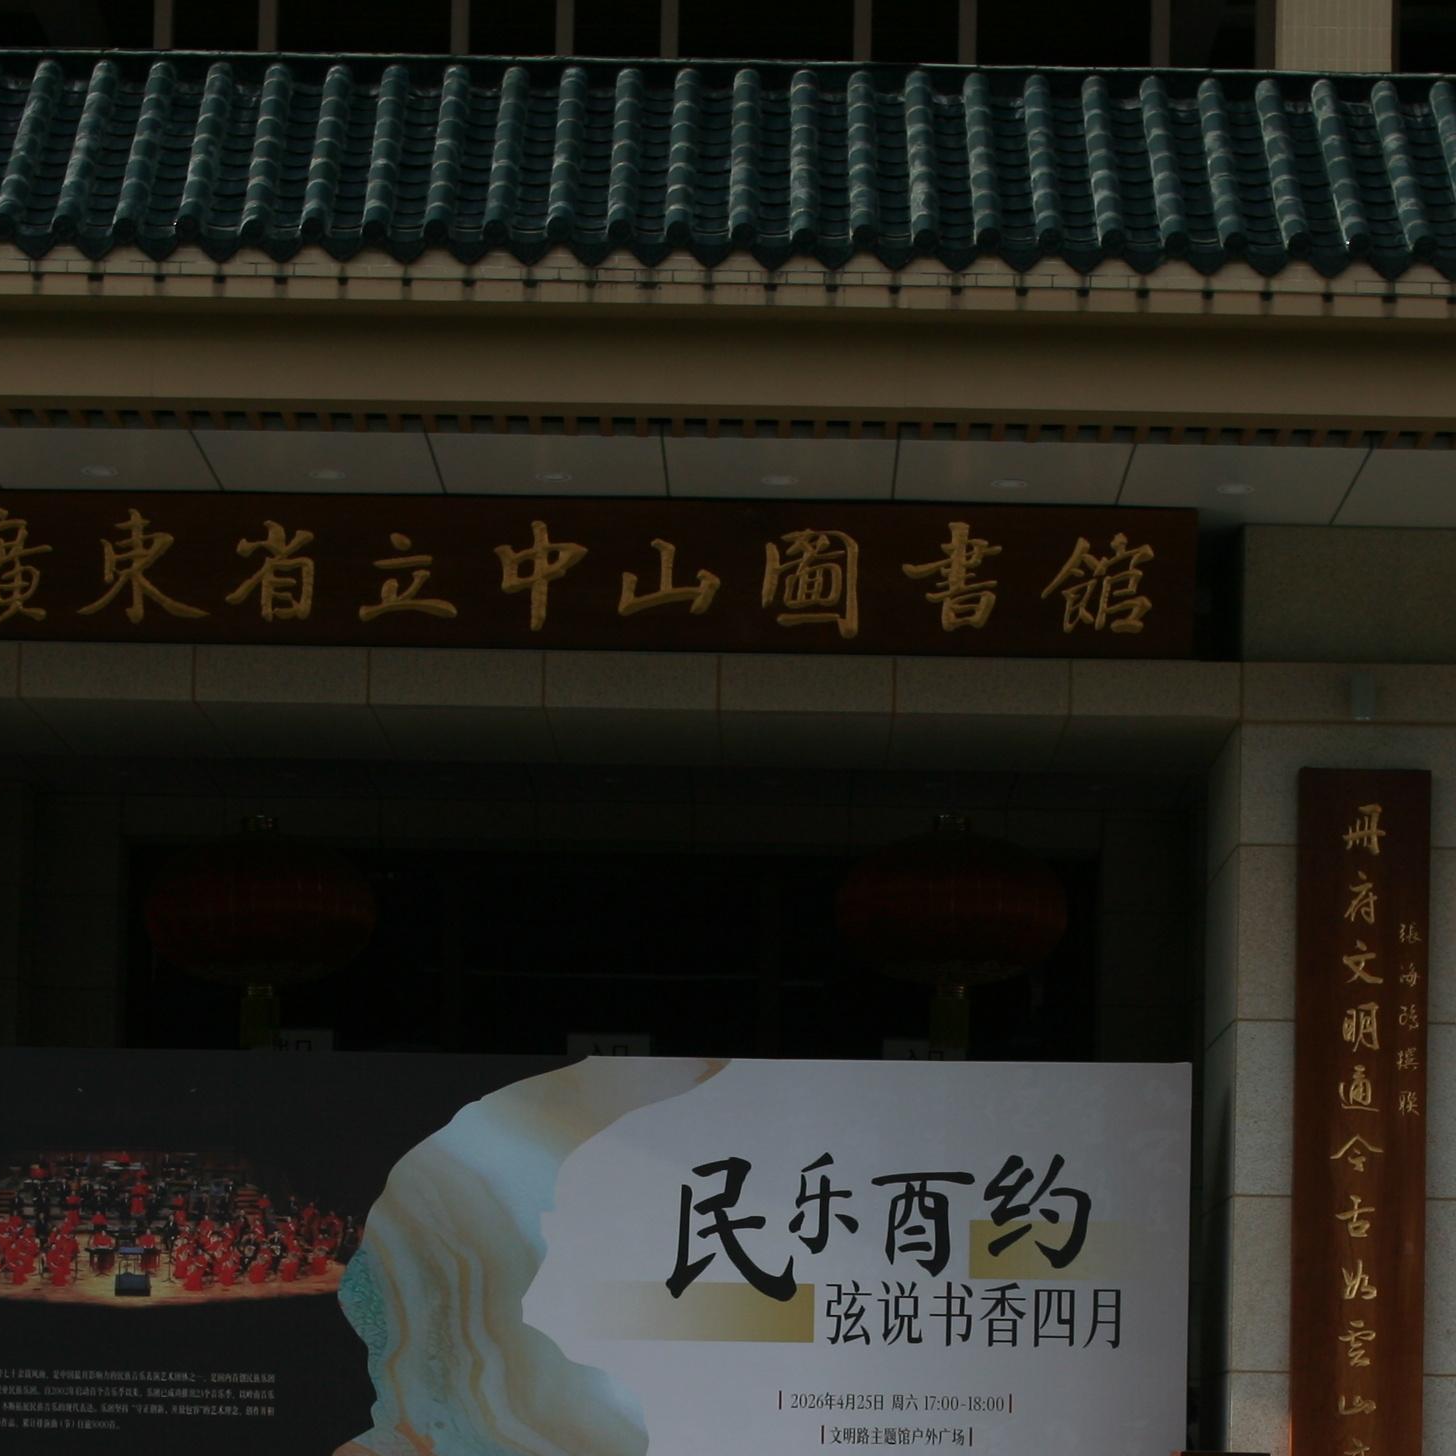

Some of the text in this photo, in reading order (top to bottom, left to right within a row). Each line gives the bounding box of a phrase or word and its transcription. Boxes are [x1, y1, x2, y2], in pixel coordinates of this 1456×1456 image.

[665, 1152, 1092, 1301] 民乐酉约
[824, 1279, 1123, 1349] 弦说书香四月
[790, 1393, 1005, 1412] 2026年4月25日 周六 17:00-18:00
[829, 1426, 966, 1446] 文明路主题馆户外广场
